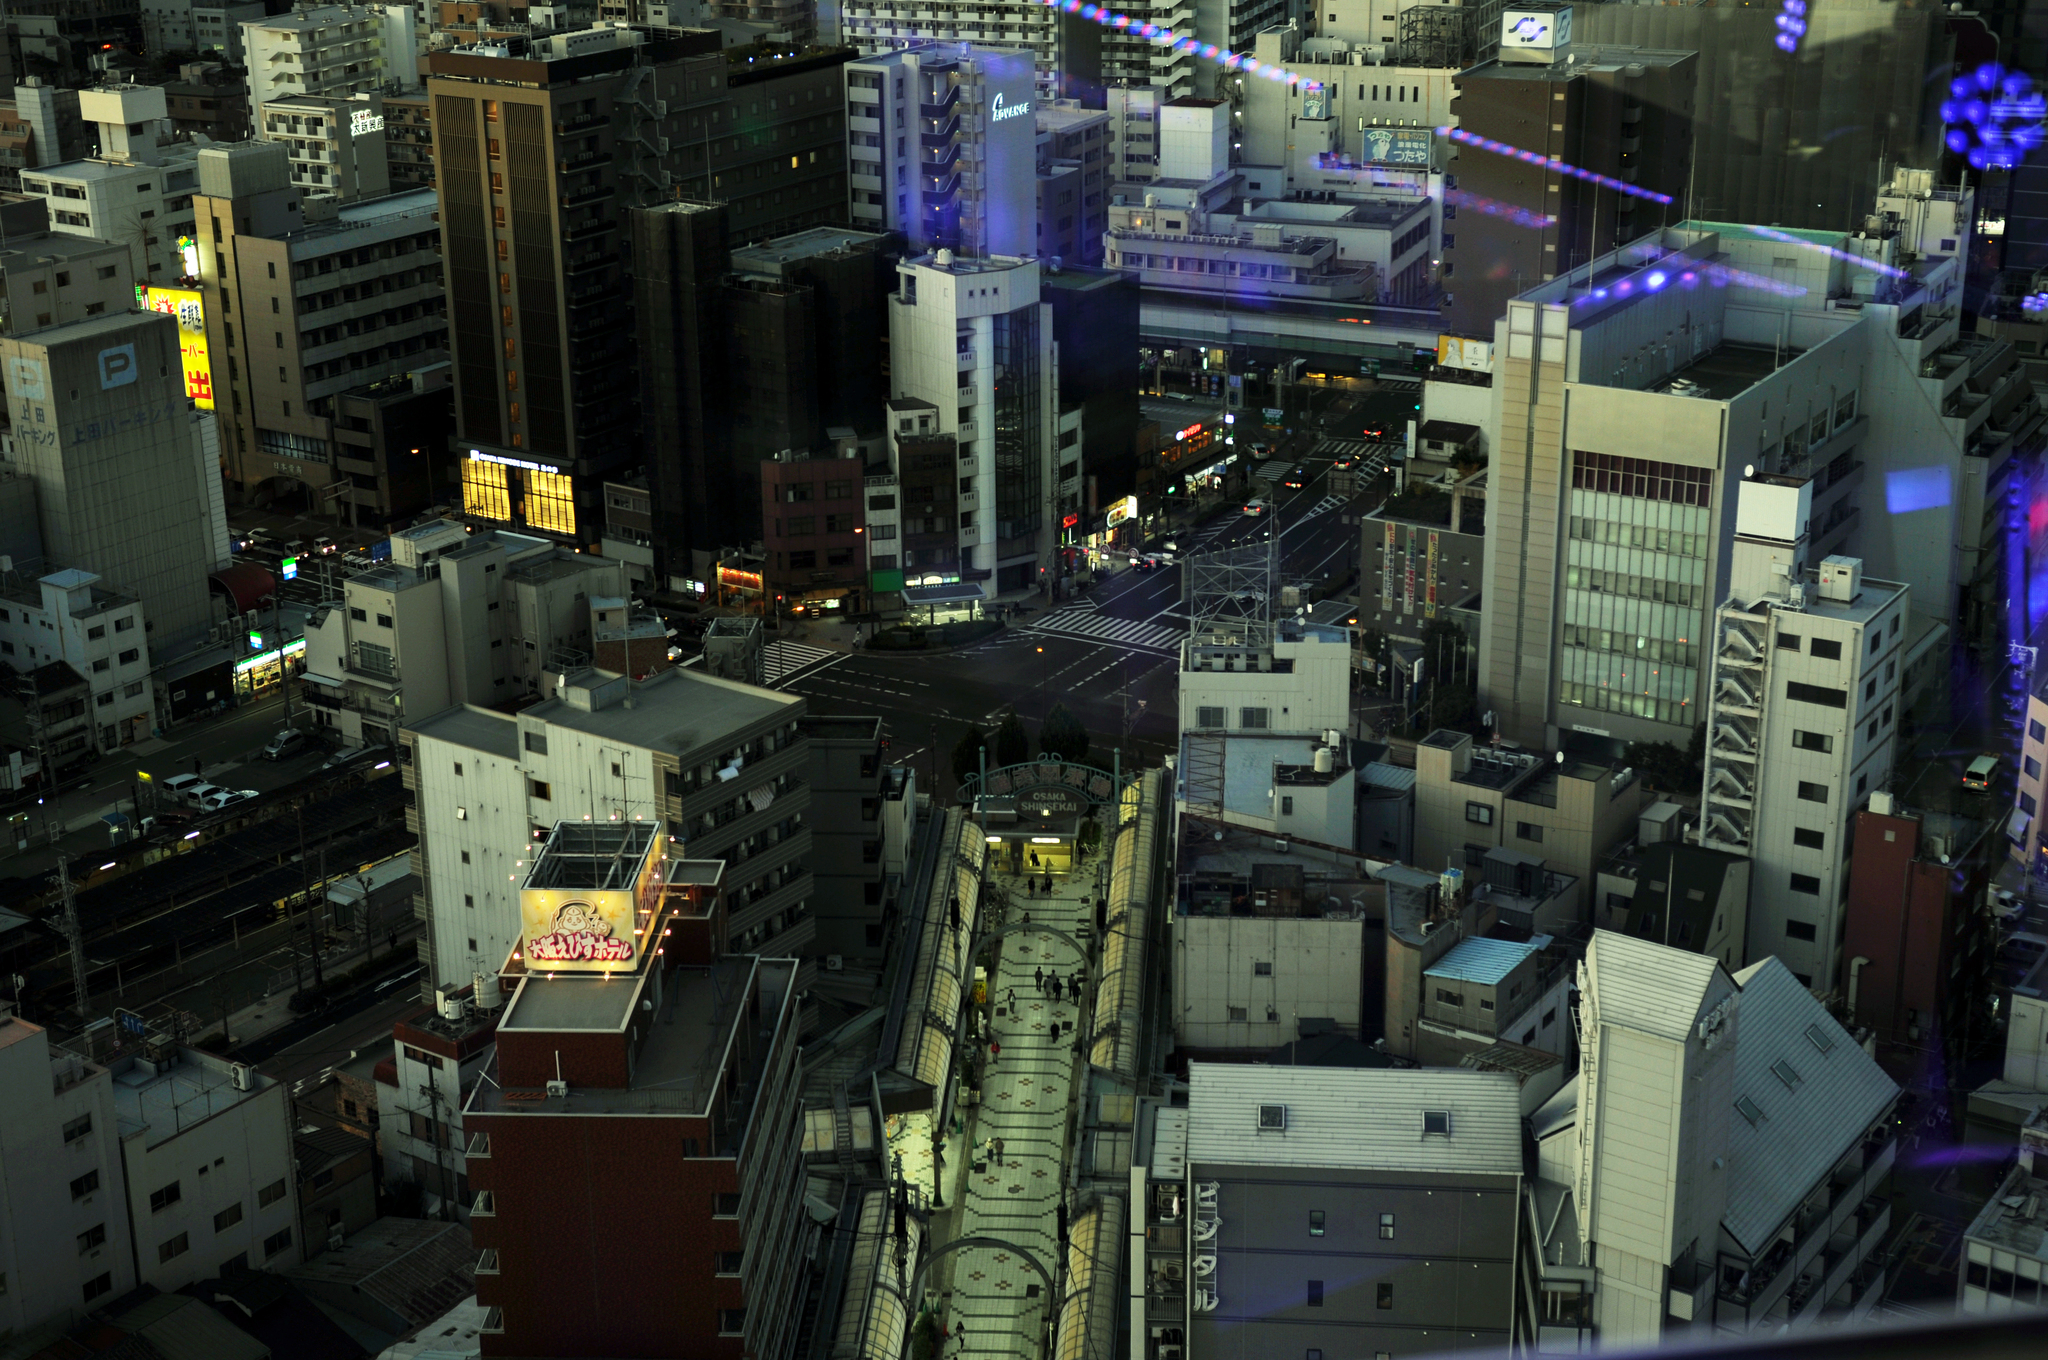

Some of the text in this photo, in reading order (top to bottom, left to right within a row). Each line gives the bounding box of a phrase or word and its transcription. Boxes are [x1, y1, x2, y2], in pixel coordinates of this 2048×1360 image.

[993, 102, 1029, 122] ADVANCE
[1393, 150, 1427, 163] つたや
[180, 344, 205, 358] ーパー
[21, 404, 45, 424] 上田
[16, 425, 56, 447] パーキング
[1033, 792, 1066, 801] OSAKA
[1021, 801, 1077, 812] SHINSEKAI
[527, 931, 633, 961] 大阪えびすホテル
